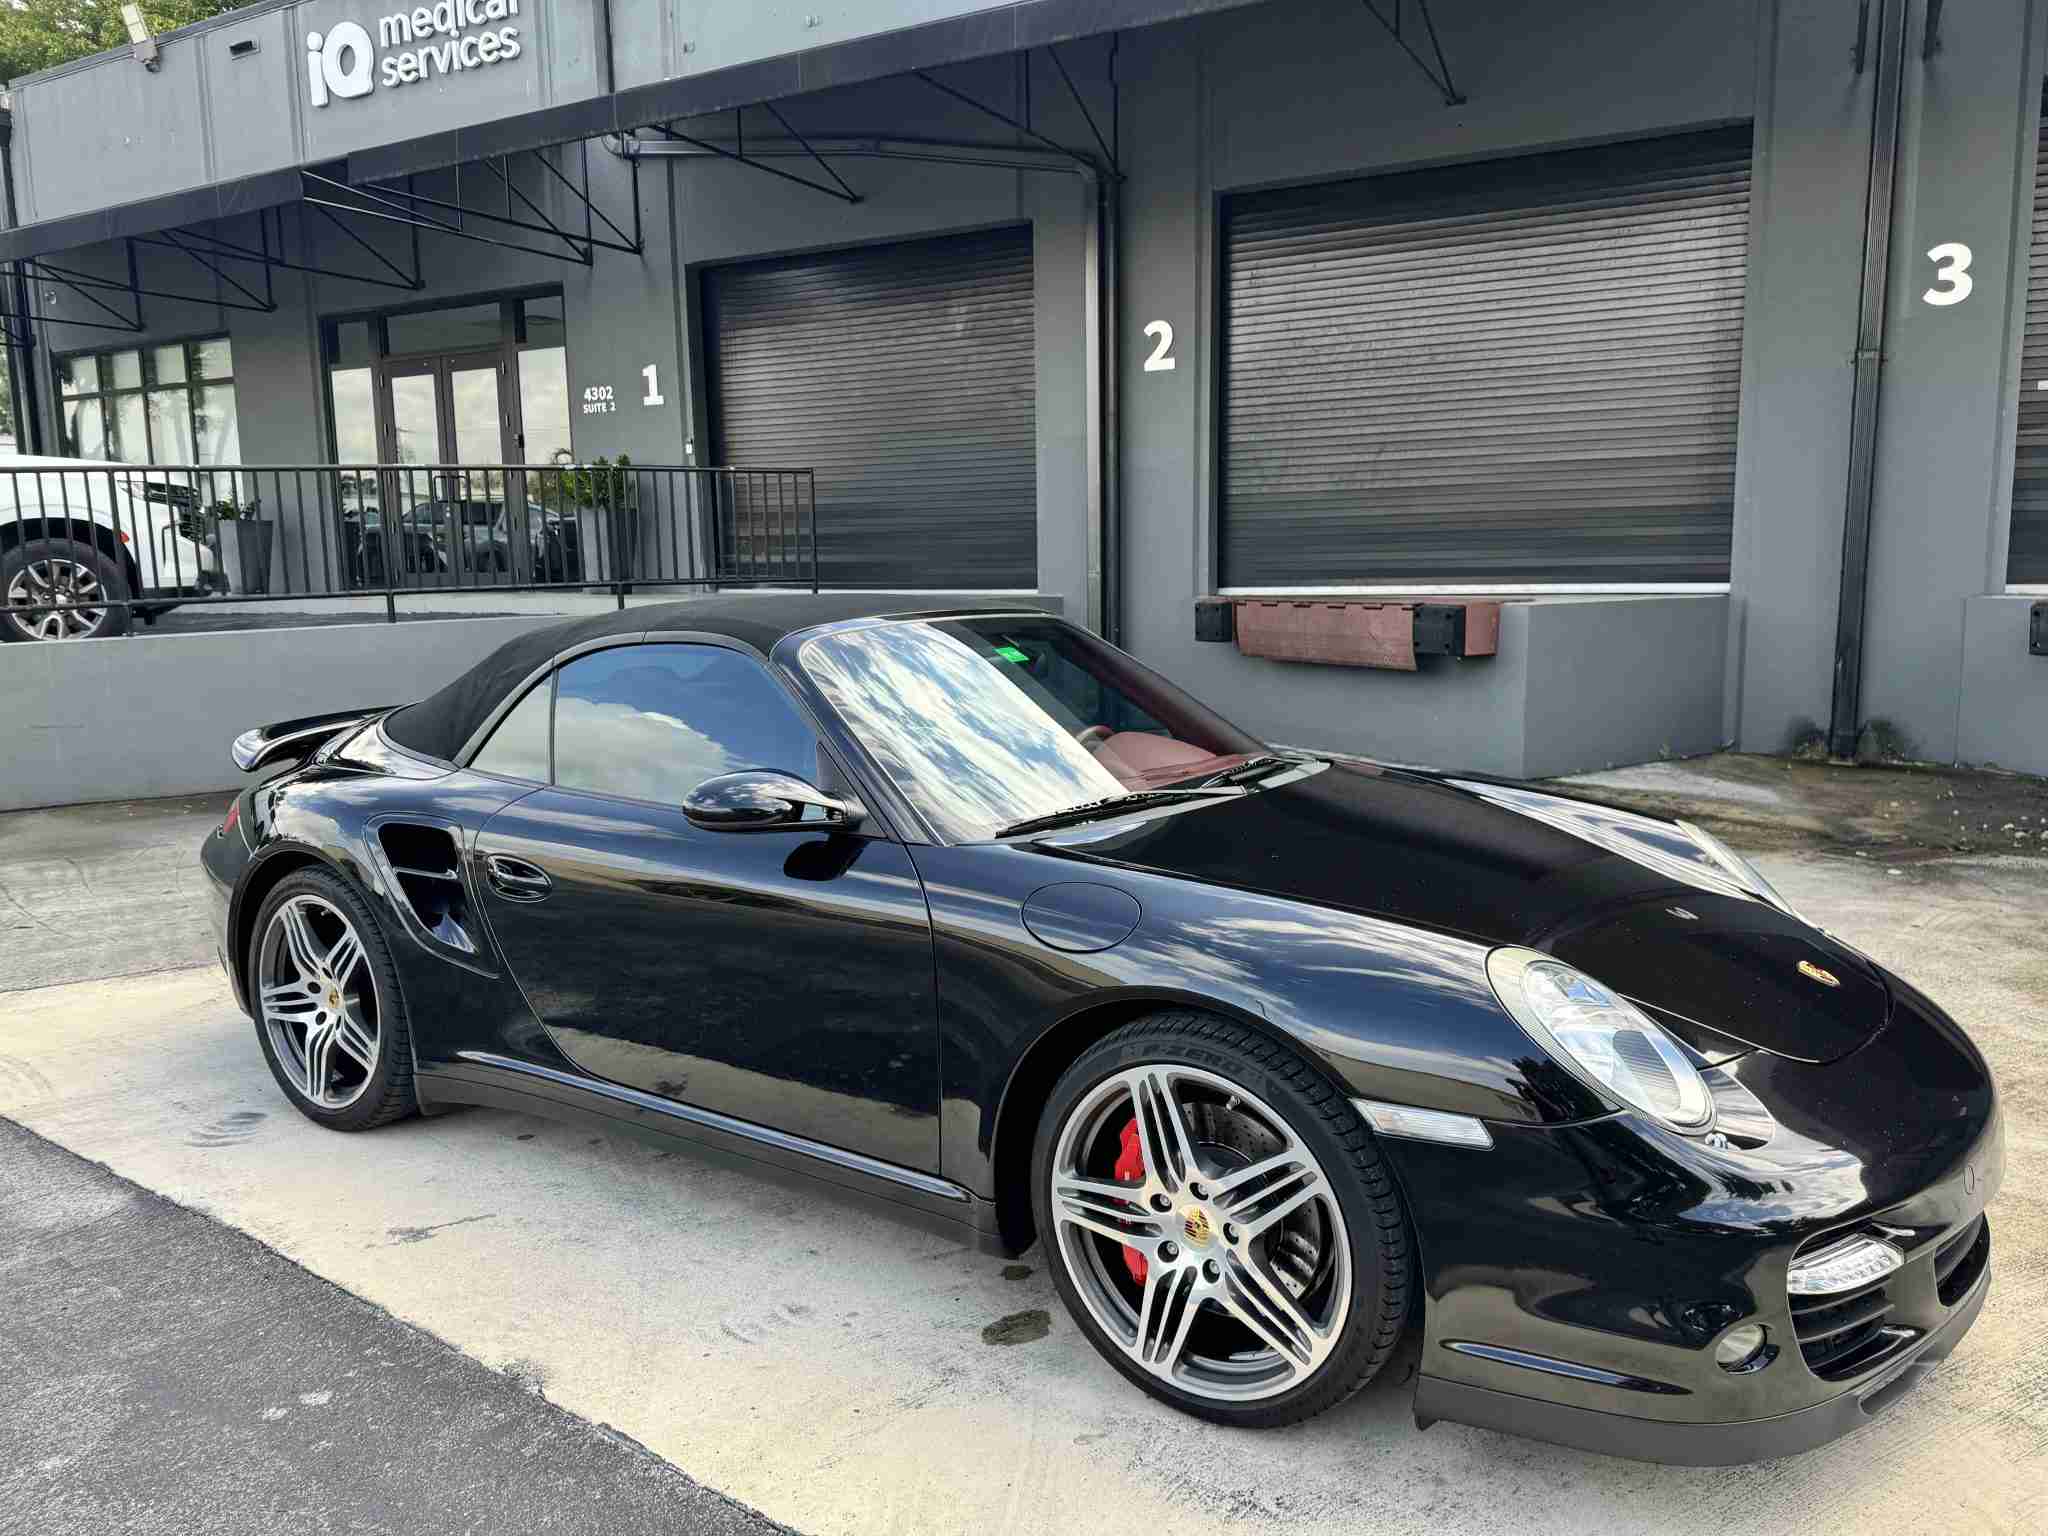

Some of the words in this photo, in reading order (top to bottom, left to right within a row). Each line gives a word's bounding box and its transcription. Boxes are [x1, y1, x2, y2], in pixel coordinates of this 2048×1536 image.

[306, 21, 375, 107] iQ
[381, 26, 521, 87] services
[1922, 242, 1973, 306] 3
[1143, 319, 1176, 372] 2
[583, 386, 614, 401] 4302
[583, 402, 607, 414] SUITE
[642, 364, 665, 406] 1
